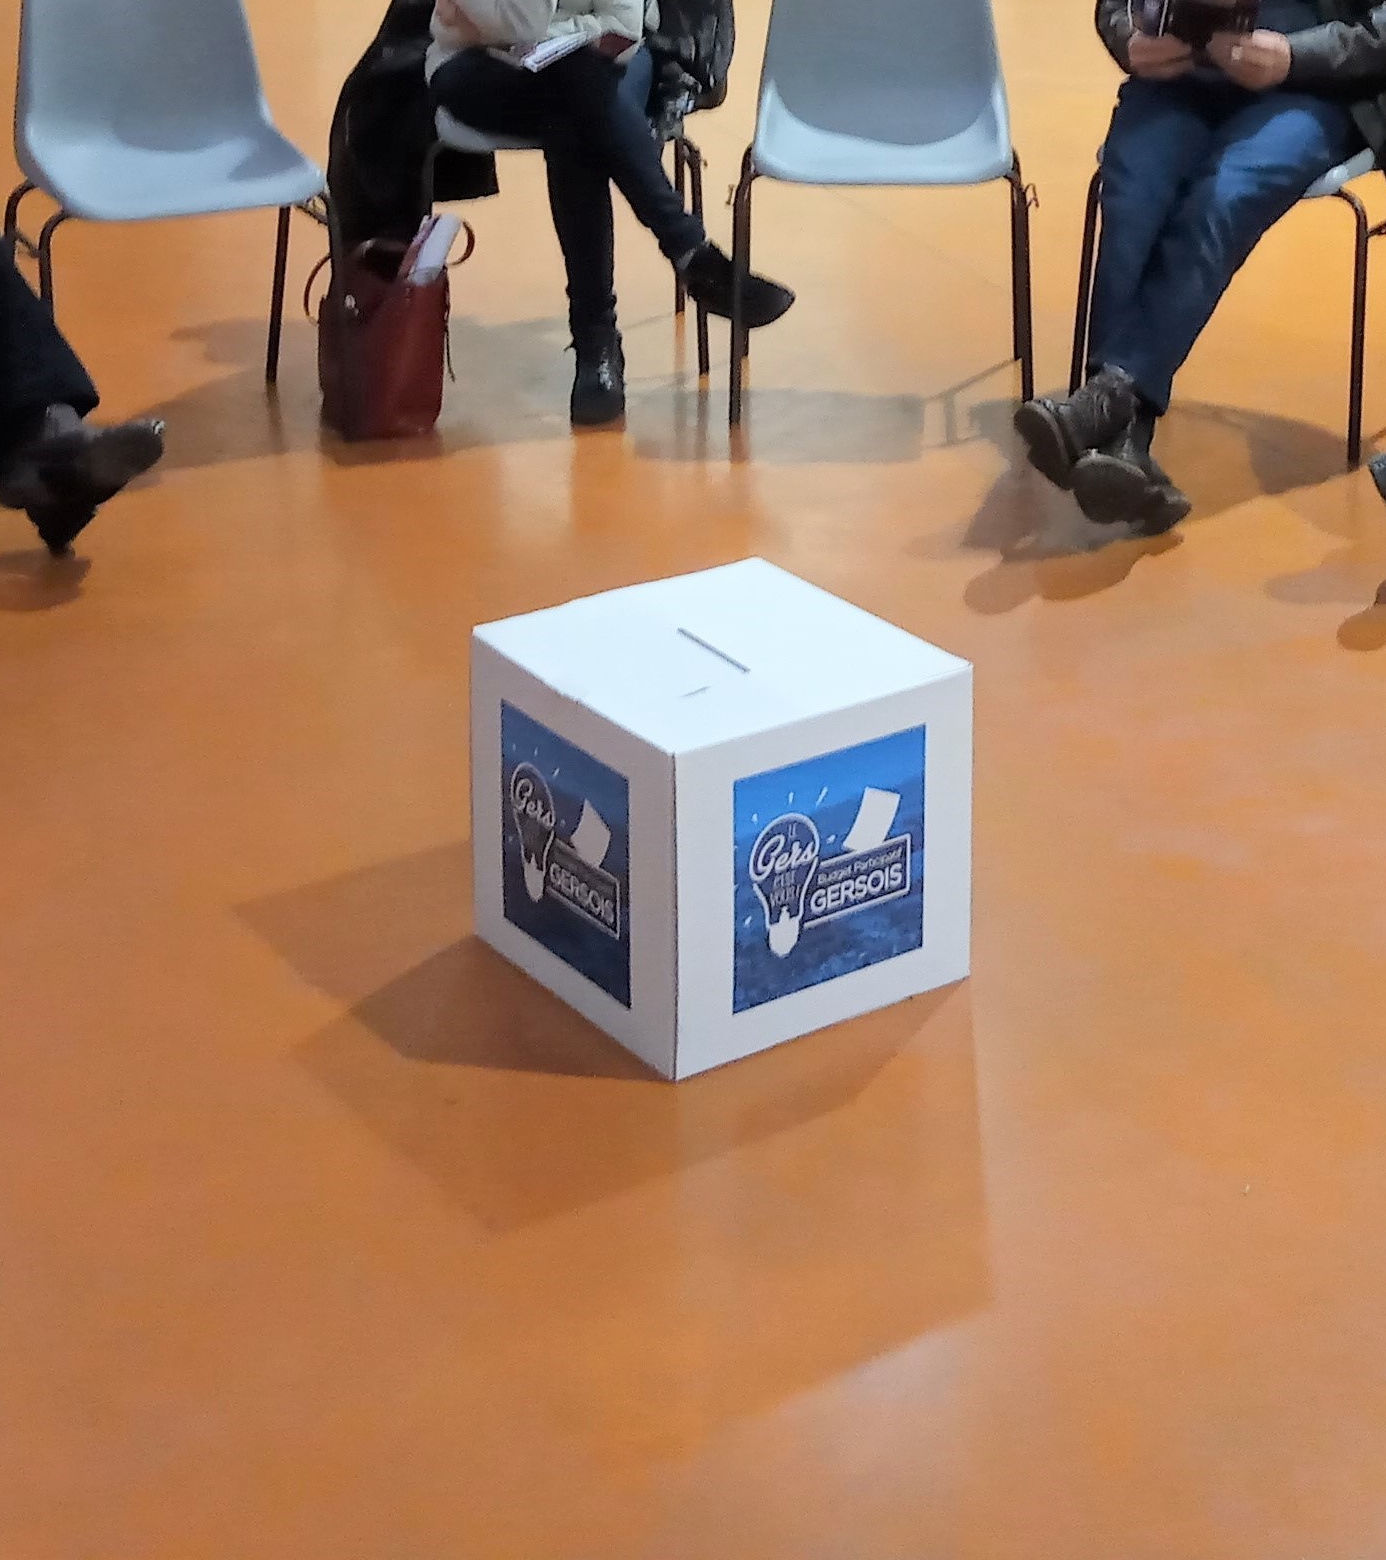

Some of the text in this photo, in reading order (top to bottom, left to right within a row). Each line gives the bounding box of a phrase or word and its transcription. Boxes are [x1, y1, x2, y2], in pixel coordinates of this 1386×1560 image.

[515, 777, 556, 828] Gers
[755, 834, 817, 881] Gers
[817, 864, 853, 886] Budget
[549, 861, 615, 924] GERSOIS
[810, 862, 903, 914] GERSOIS
